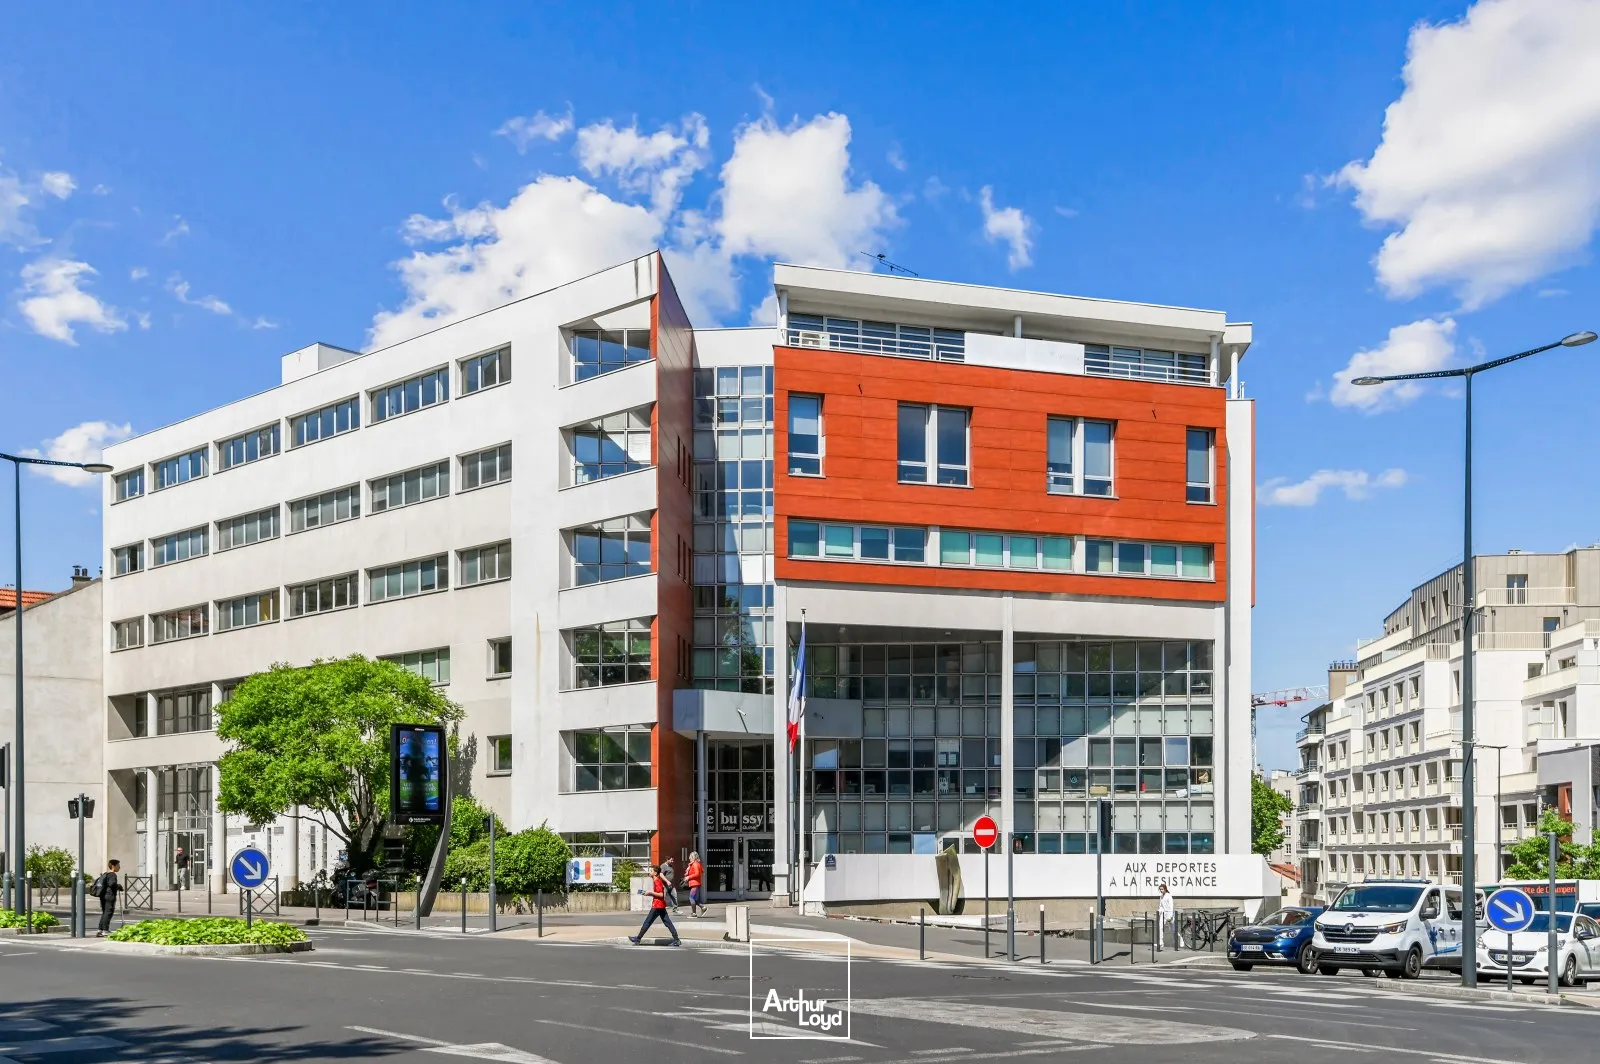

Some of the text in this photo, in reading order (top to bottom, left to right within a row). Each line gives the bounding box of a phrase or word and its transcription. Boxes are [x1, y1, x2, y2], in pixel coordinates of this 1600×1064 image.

[1125, 862, 1217, 873] AUX DEPORTES
[1109, 876, 1217, 887] A LA RESISTANCE
[1536, 886, 1544, 894] de
